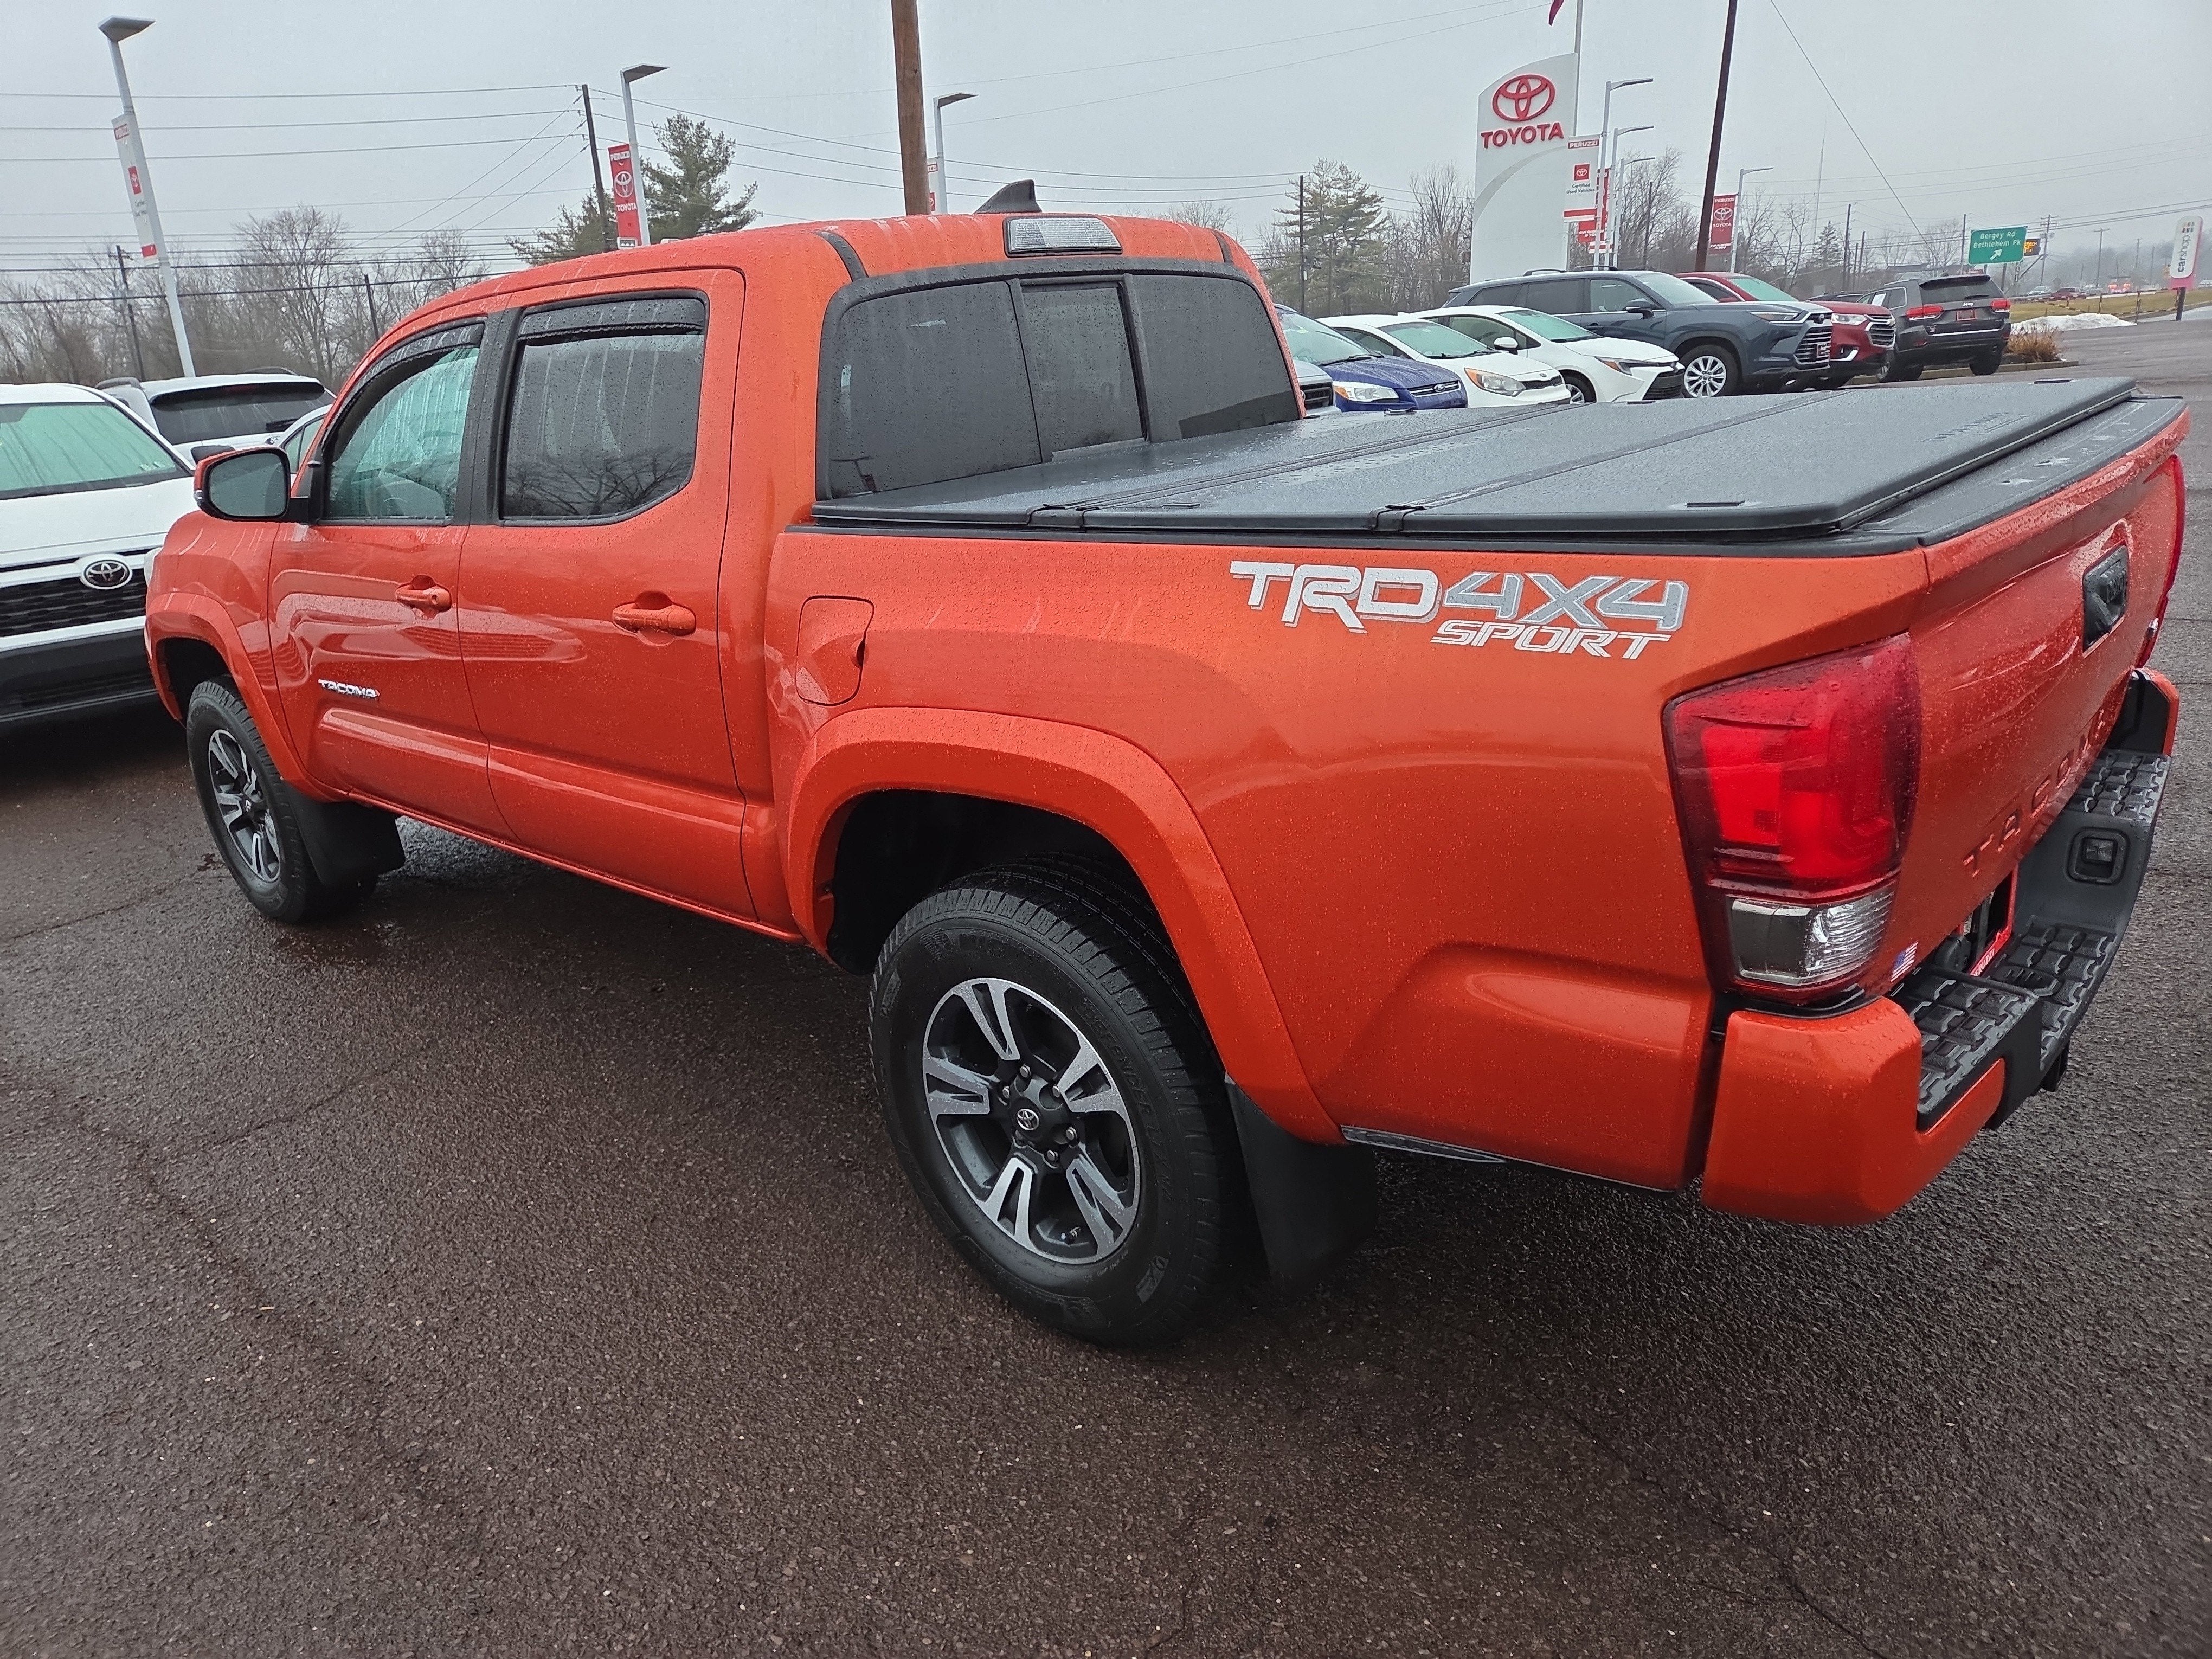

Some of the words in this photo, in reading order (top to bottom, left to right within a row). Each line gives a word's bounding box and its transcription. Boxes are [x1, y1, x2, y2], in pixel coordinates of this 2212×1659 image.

[1481, 122, 1564, 149] TOYOTA
[616, 202, 637, 212] TOYOTA
[1973, 240, 2010, 248] Bethlehem
[2178, 235, 2191, 272] carshop
[1229, 560, 1442, 634] TRD
[1431, 619, 1671, 659] SPORT
[318, 679, 380, 698] TACOMA
